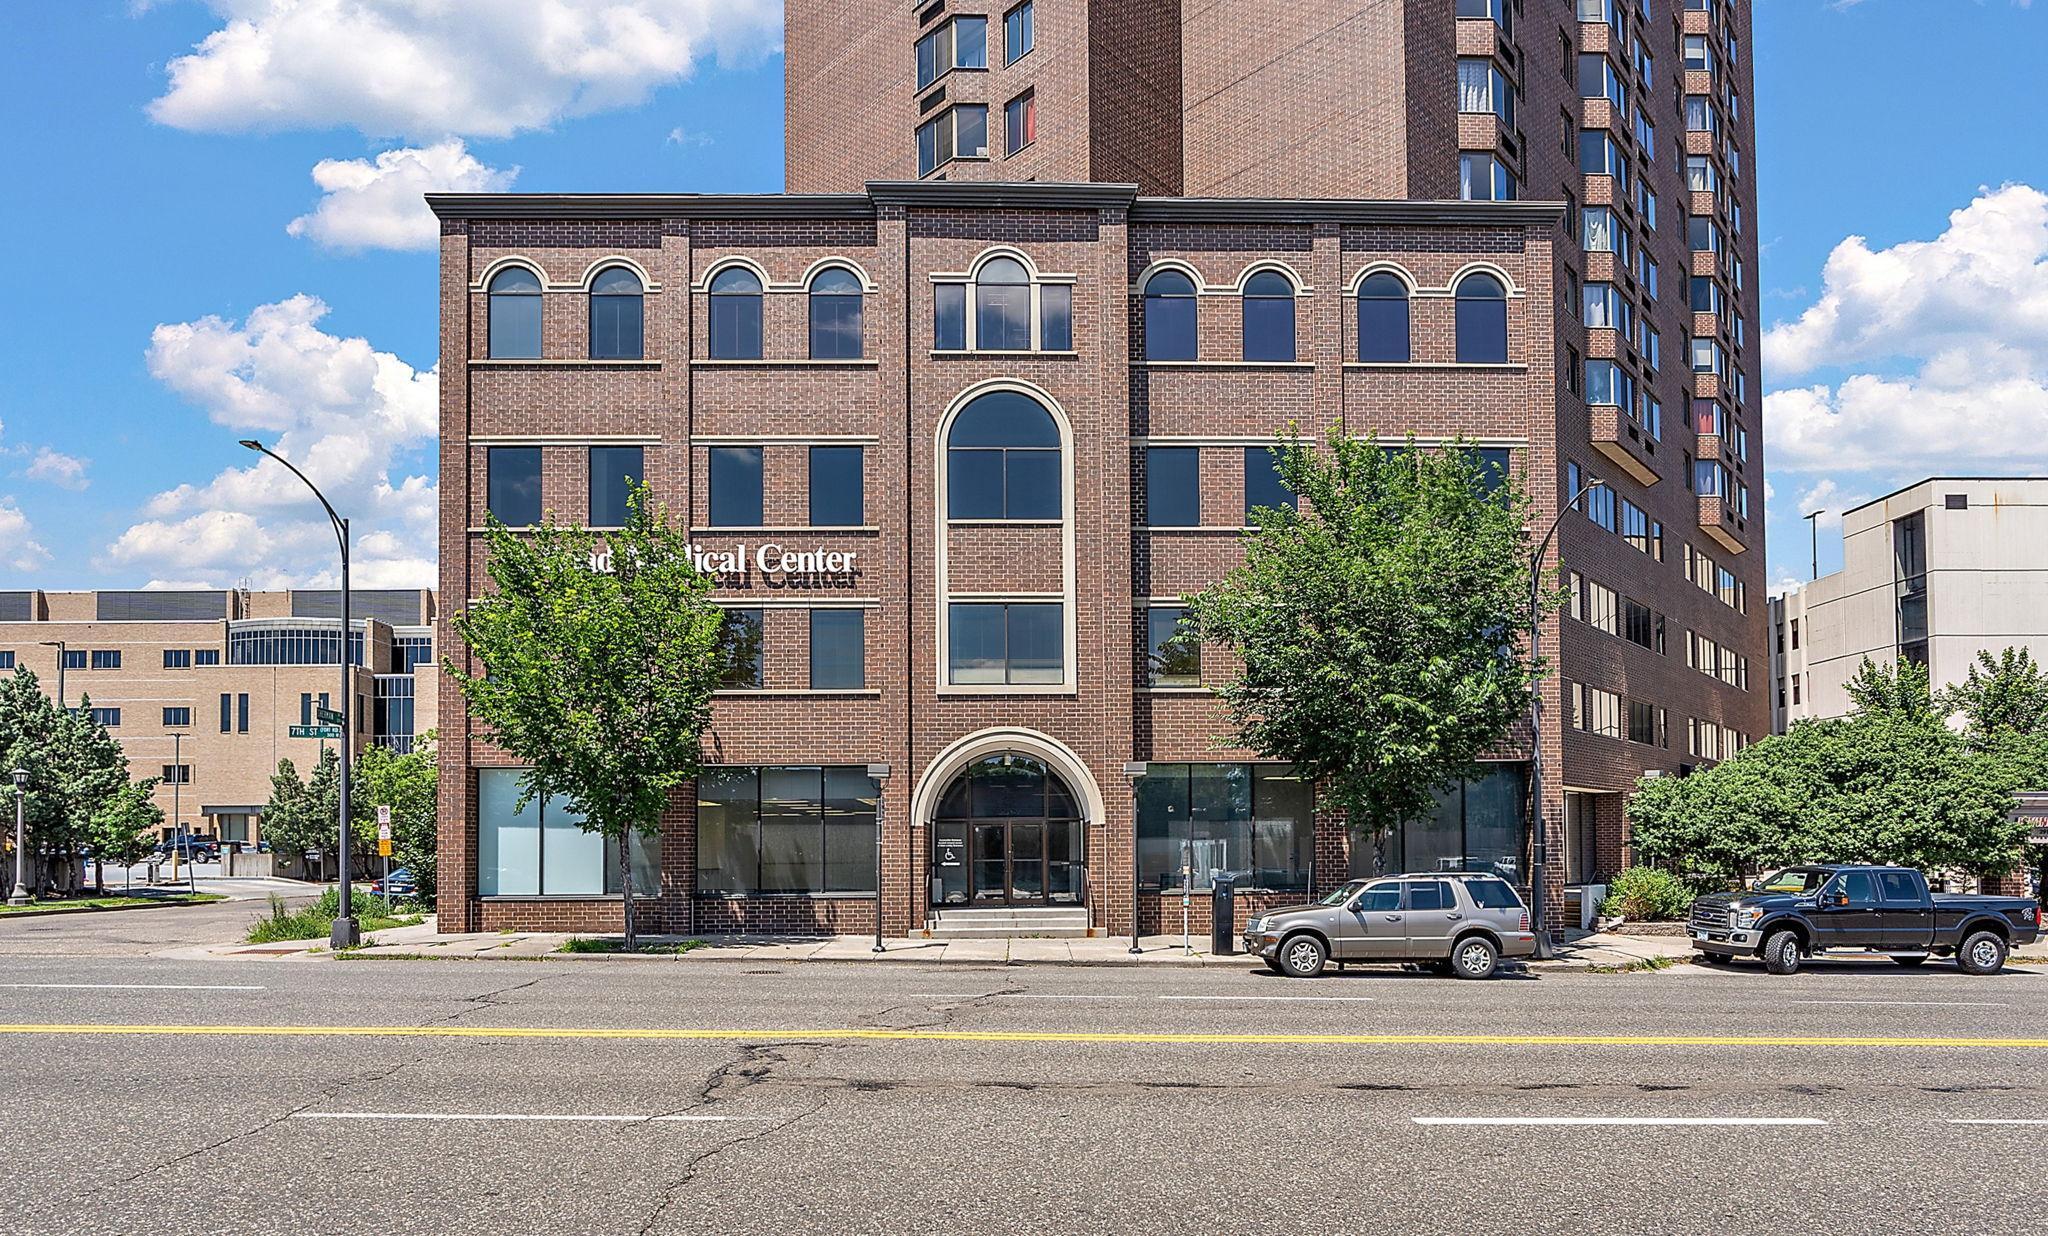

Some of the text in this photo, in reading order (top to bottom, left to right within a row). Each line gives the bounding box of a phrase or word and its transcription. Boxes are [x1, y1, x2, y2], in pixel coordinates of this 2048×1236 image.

[627, 544, 746, 574] ical
[756, 543, 857, 574] Center
[291, 727, 318, 736] 7TH ST
